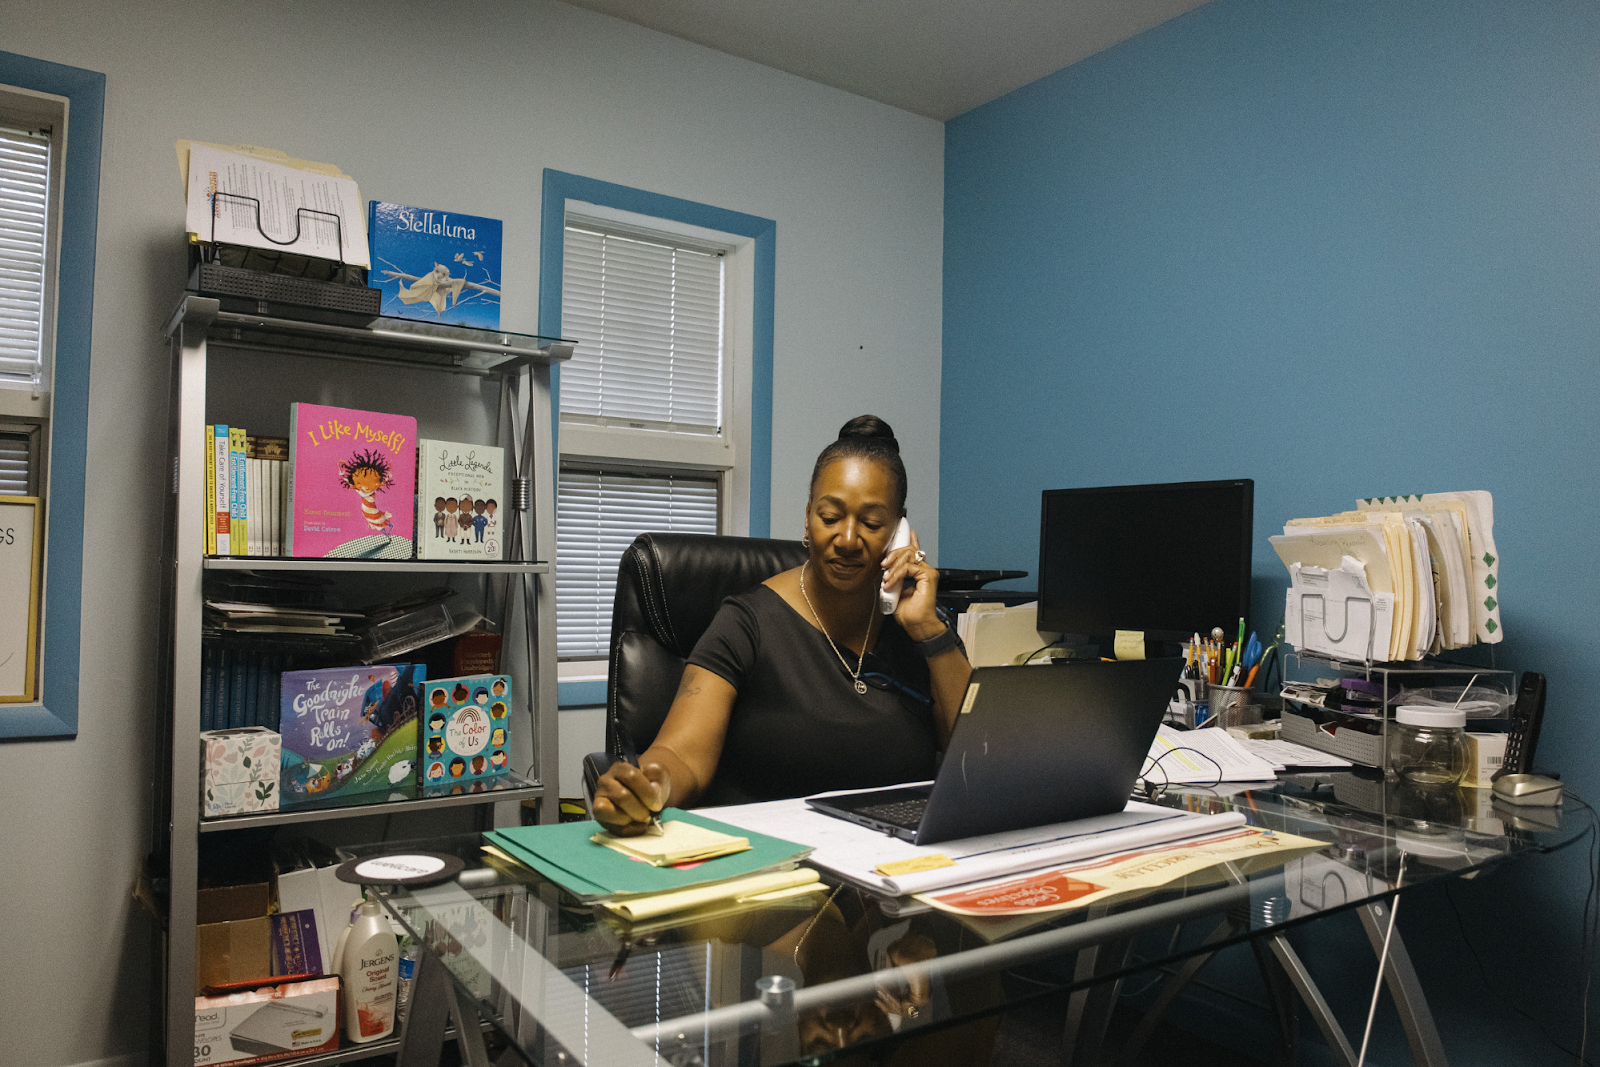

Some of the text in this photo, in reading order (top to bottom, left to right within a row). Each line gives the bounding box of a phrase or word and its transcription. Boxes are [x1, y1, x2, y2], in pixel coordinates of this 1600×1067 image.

[397, 211, 476, 240] Stellaluna
[307, 420, 406, 455] I Like Myself!
[218, 440, 226, 452] Take
[218, 457, 226, 471] Care
[439, 450, 493, 474] Little Legends
[218, 473, 227, 481] of
[218, 482, 227, 508] Yourself
[239, 503, 247, 518] Child
[306, 678, 321, 691] The
[293, 674, 365, 718] Goodnight
[310, 703, 351, 725] Train
[310, 721, 342, 747] Rolls
[449, 722, 487, 737] The Color
[468, 736, 479, 747] Us
[359, 953, 395, 971] JERGENS
[366, 966, 390, 977] Original
[369, 973, 387, 982] Scent
[234, 1057, 256, 1066] Envelopes
